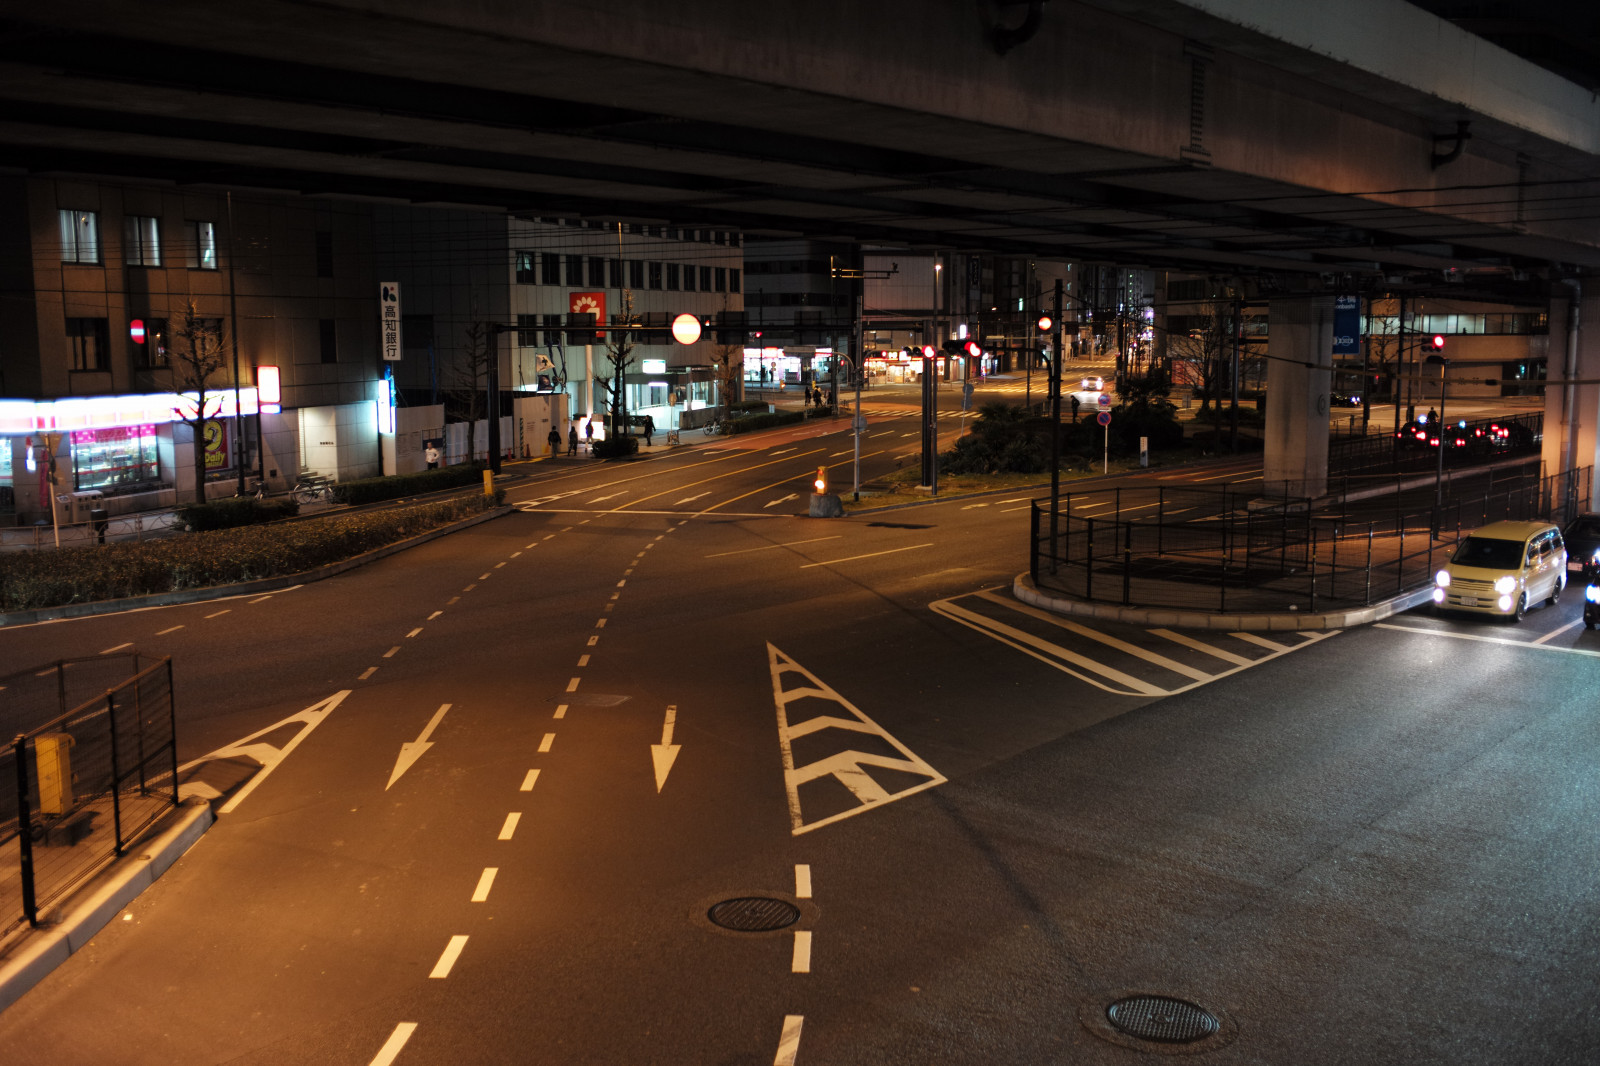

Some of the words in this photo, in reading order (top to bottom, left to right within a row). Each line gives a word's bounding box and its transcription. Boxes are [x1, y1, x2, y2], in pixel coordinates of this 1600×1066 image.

[385, 306, 397, 357] 高知銀行
[204, 451, 226, 465] Daily
